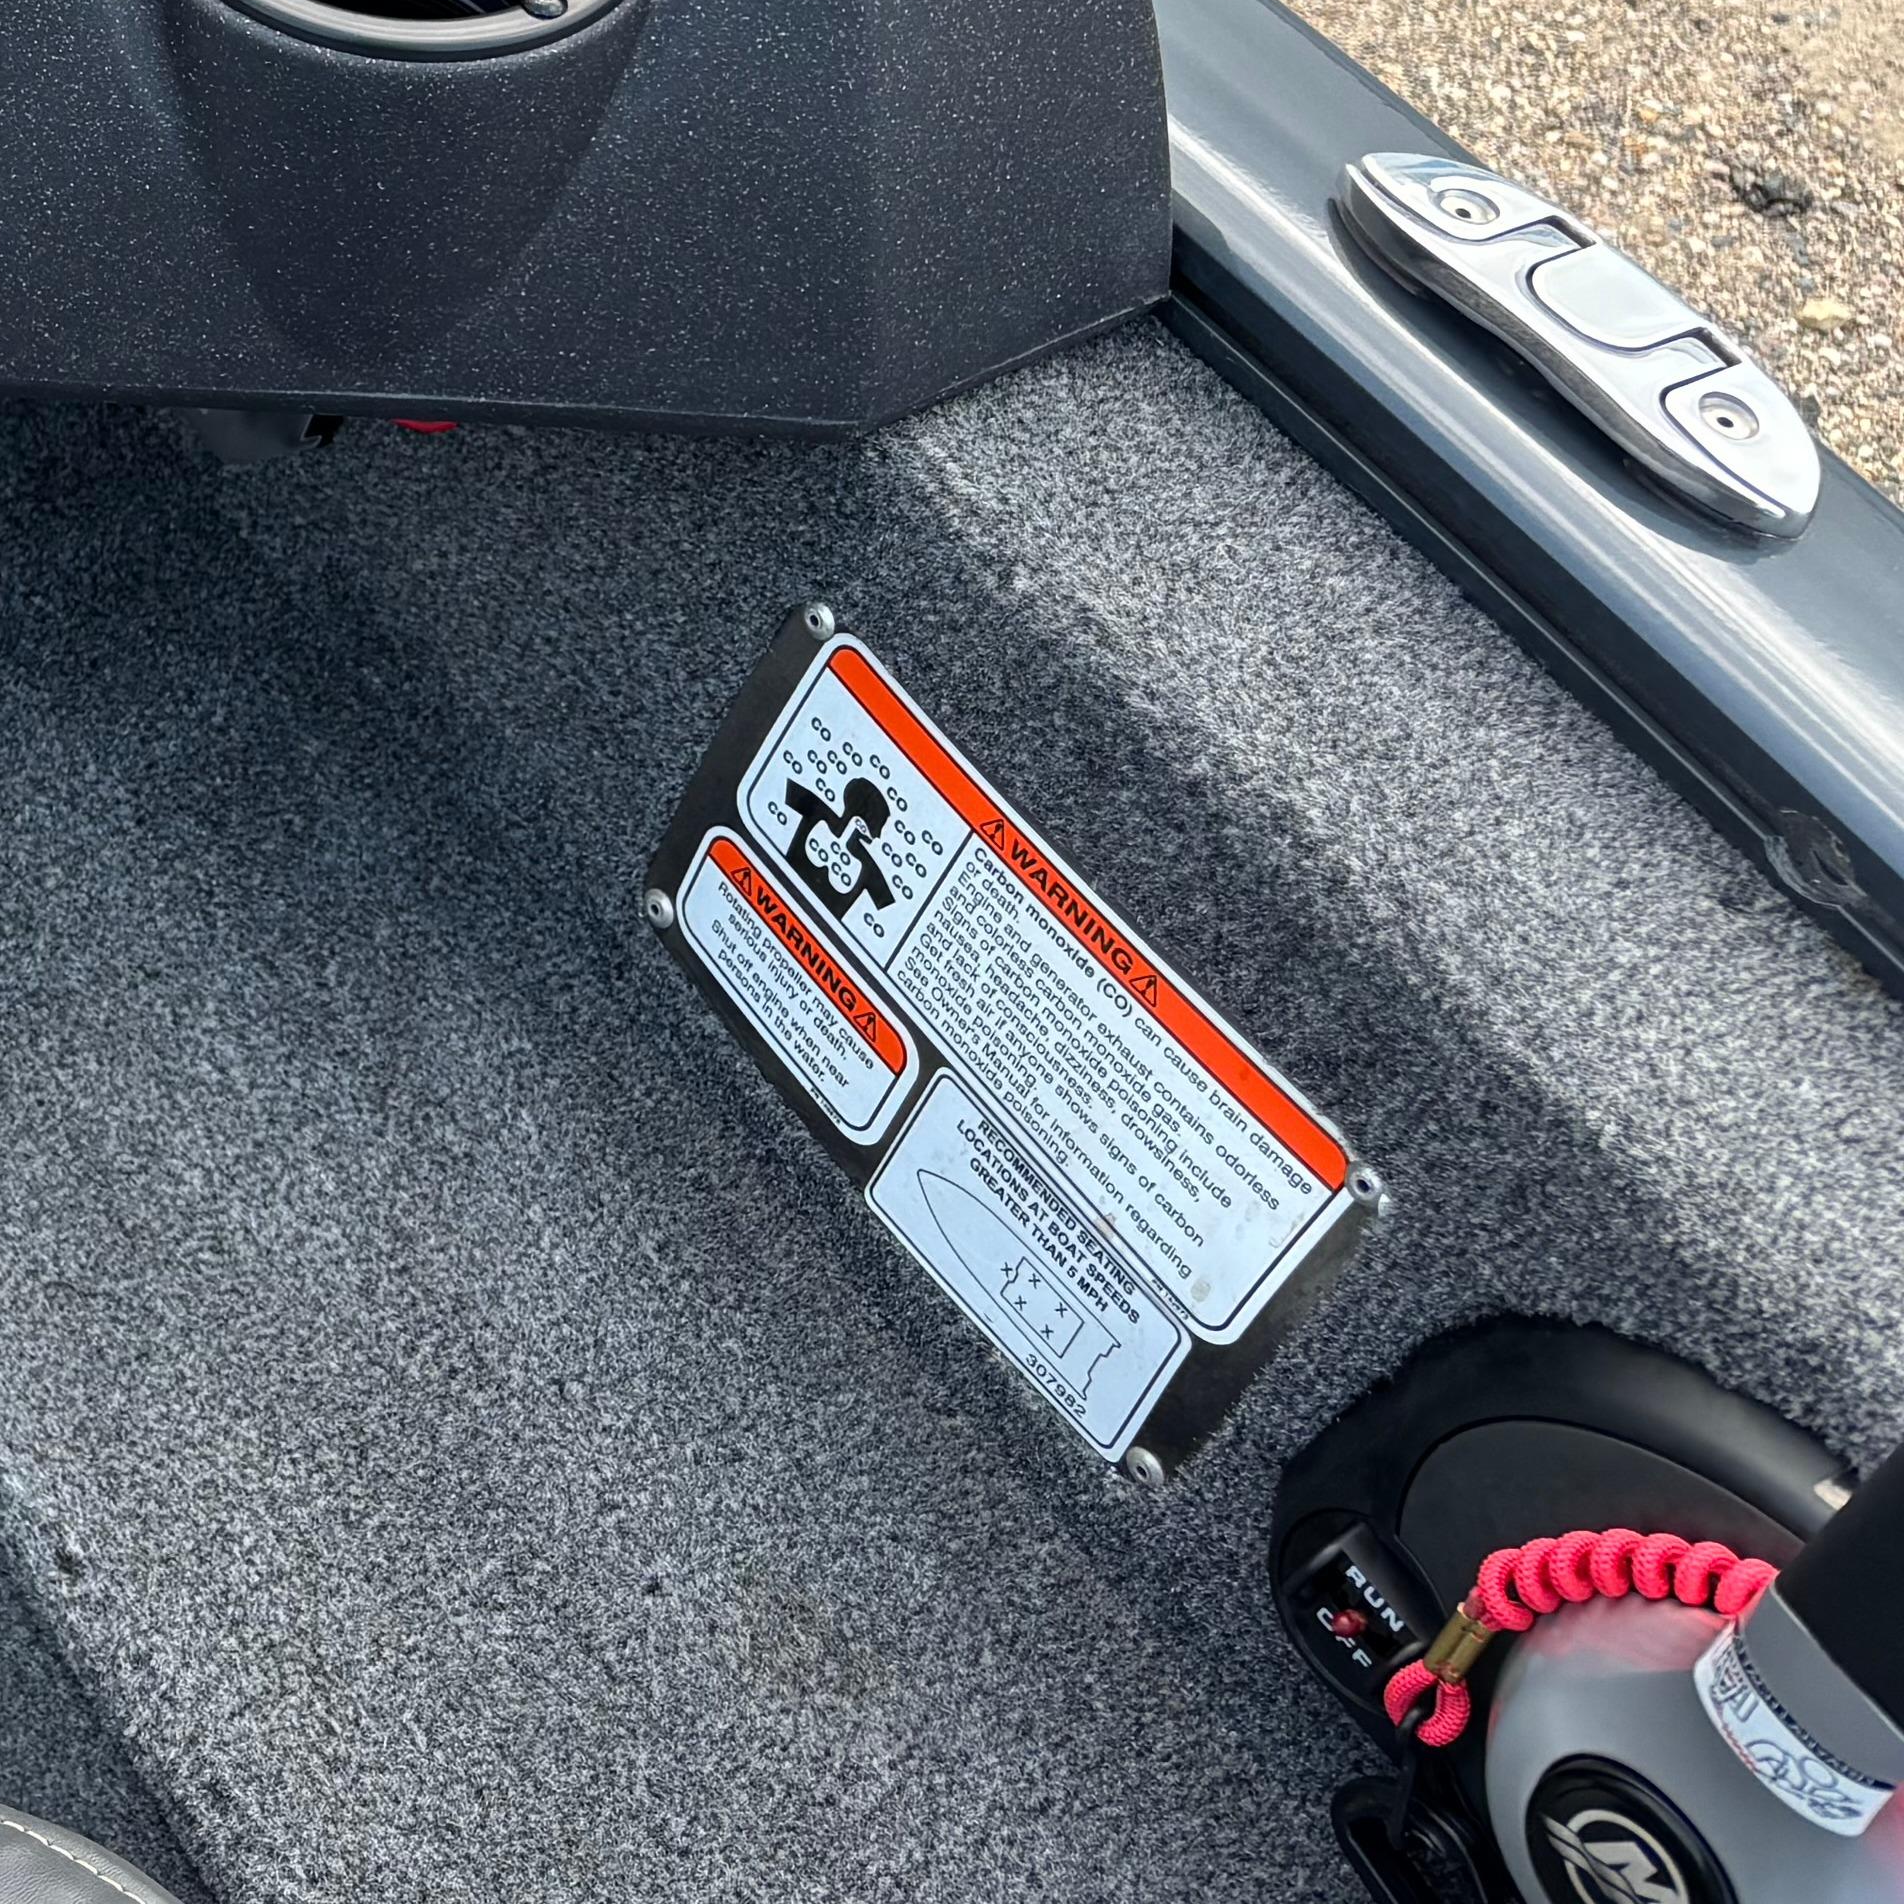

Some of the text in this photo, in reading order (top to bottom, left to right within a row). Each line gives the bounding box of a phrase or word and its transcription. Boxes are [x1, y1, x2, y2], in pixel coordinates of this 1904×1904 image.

[782, 749, 803, 775] CO
[807, 749, 828, 775] CO
[811, 716, 832, 742] CO
[842, 741, 863, 767] CO
[815, 777, 836, 803] CO
[826, 750, 848, 775] CO
[869, 754, 891, 780] CO
[767, 801, 788, 826] CO
[886, 786, 908, 812] CO
[808, 837, 829, 867] CO
[830, 840, 851, 866] CO
[881, 842, 903, 868] CO
[894, 819, 916, 846] CO
[905, 852, 927, 879] CO
[921, 829, 944, 856] CO
[827, 861, 852, 887] CO
[891, 874, 914, 900] CO
[965, 861, 1020, 924] or death.
[1011, 838, 1134, 975] WARNING
[756, 885, 857, 1013] WARNING
[863, 912, 885, 938] CO
[711, 919, 737, 955] Shut
[736, 953, 754, 973] off
[751, 972, 790, 1019] engine
[790, 1017, 821, 1057] when
[821, 1055, 850, 1088] near
[718, 881, 874, 1070] Rotating propeller may cause
[727, 913, 767, 963] serious
[767, 959, 799, 1000] injury
[799, 999, 814, 1016] or
[813, 1016, 847, 1061] death.
[717, 948, 761, 1003] persons
[761, 999, 773, 1019] in
[774, 1015, 793, 1041] the
[793, 1039, 825, 1082] water.
[908, 945, 1037, 1091] monoxide poisoning.
[926, 922, 1093, 1109] and lack of consciousness.
[949, 885, 1181, 1137] and colorless carbon monoxide gas.
[957, 870, 1280, 1211] Engine and generator exhaust contains odorless
[974, 847, 1313, 1195] Carbon monoxide (CO) can cause brain damage
[897, 969, 1069, 1167] carbon monoxide poisoning.
[933, 909, 981, 968] nausea,
[984, 963, 1050, 1042] headache,
[1054, 1041, 1116, 1115] dizziness,
[1120, 1113, 1200, 1203] drowsiness,
[941, 896, 1232, 1208] Signs of carbon monoxide poisoning include
[904, 955, 929, 988] See
[930, 986, 981, 1046] Owner's
[981, 1042, 1033, 1099] Manual
[1029, 1096, 1051, 1120] for
[1049, 1118, 1124, 1204] information
[1125, 1203, 1193, 1280] regarding
[919, 932, 943, 963] Get
[943, 959, 975, 999] fresh
[975, 998, 996, 1018] air
[994, 1015, 1008, 1030] if
[1005, 1029, 1054, 1085] anyone
[1054, 1084, 1099, 1134] shows
[1099, 1133, 1138, 1176] signs
[1138, 1175, 1157, 1193] of
[1154, 1193, 1204, 1248] carbon
[956, 1119, 1140, 1324] LOCATIONS AT BOAT SPEEDS
[970, 1157, 1109, 1312] GREATER THAN 5 MPH
[977, 1119, 1138, 1296] RECOMMENDED SEATING
[1025, 1353, 1087, 1419] 307982
[1345, 1565, 1404, 1632] RUN
